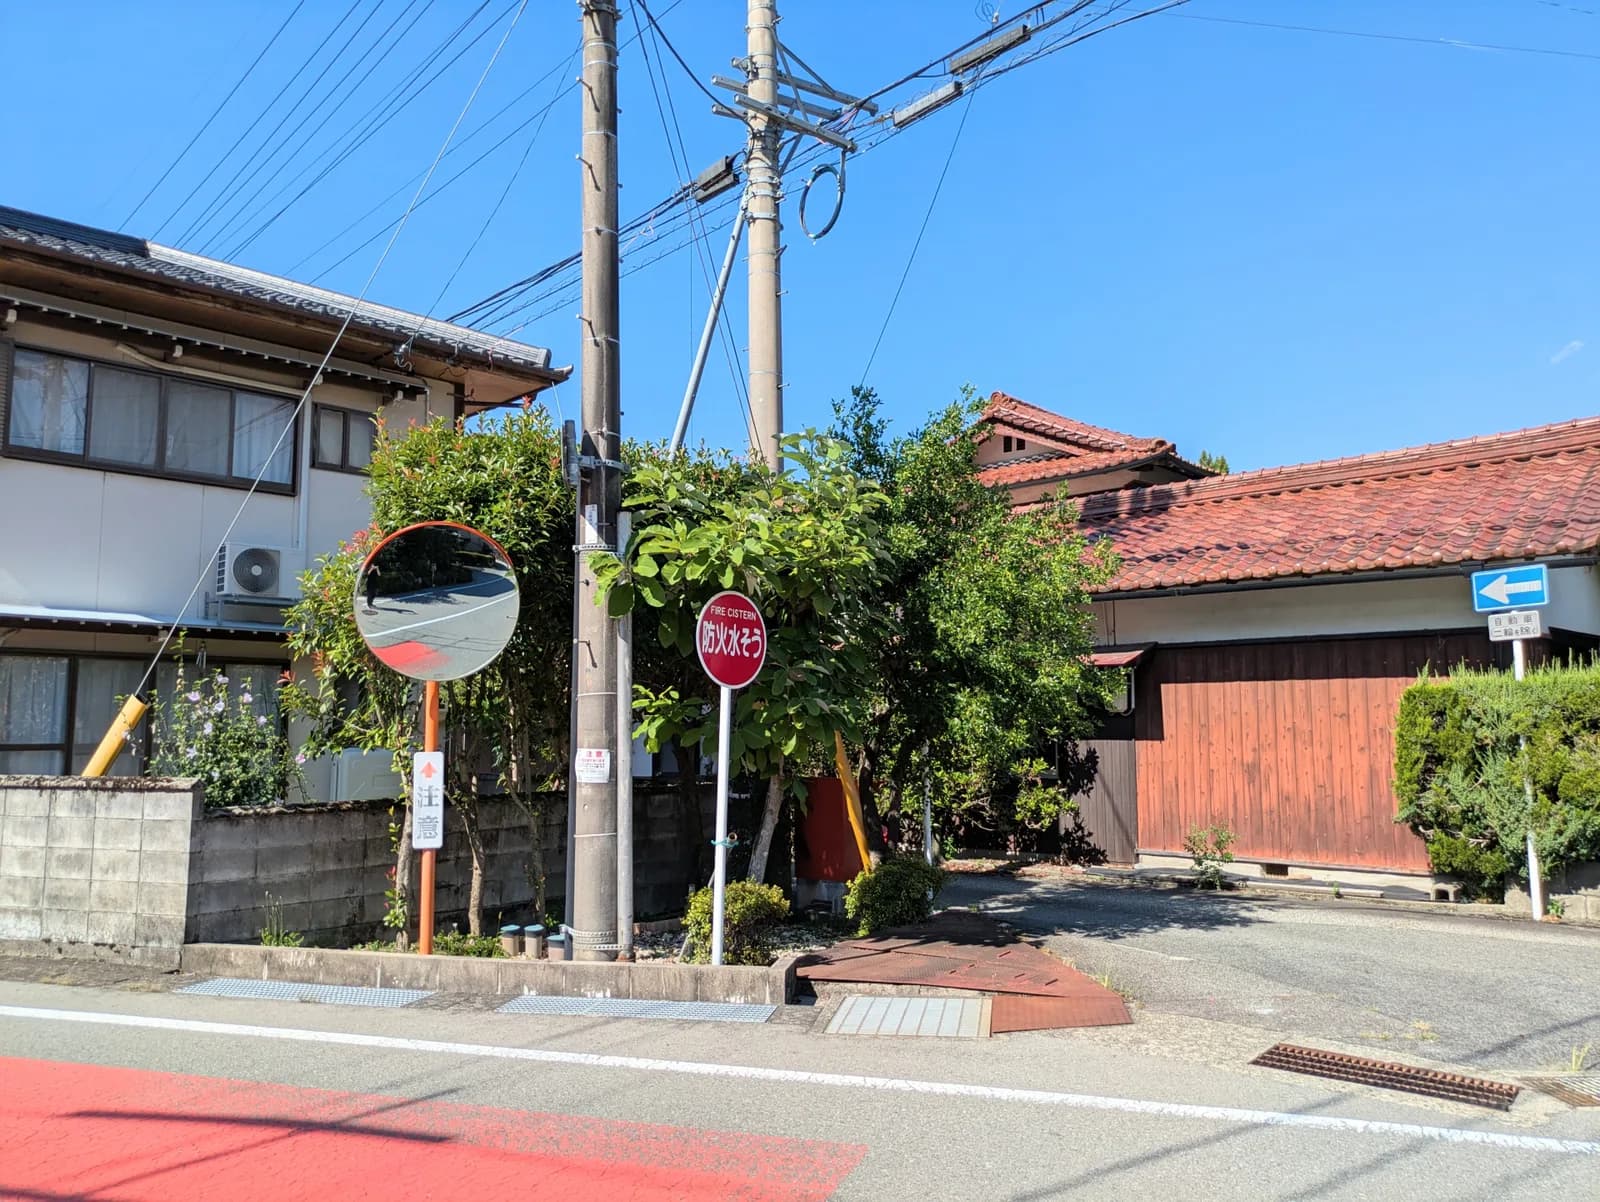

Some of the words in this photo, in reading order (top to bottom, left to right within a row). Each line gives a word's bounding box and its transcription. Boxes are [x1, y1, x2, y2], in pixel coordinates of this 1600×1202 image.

[710, 605, 726, 617] FIRE
[727, 607, 757, 621] CISTERN
[702, 620, 762, 659] 防火水そう
[417, 785, 440, 840] 注意
